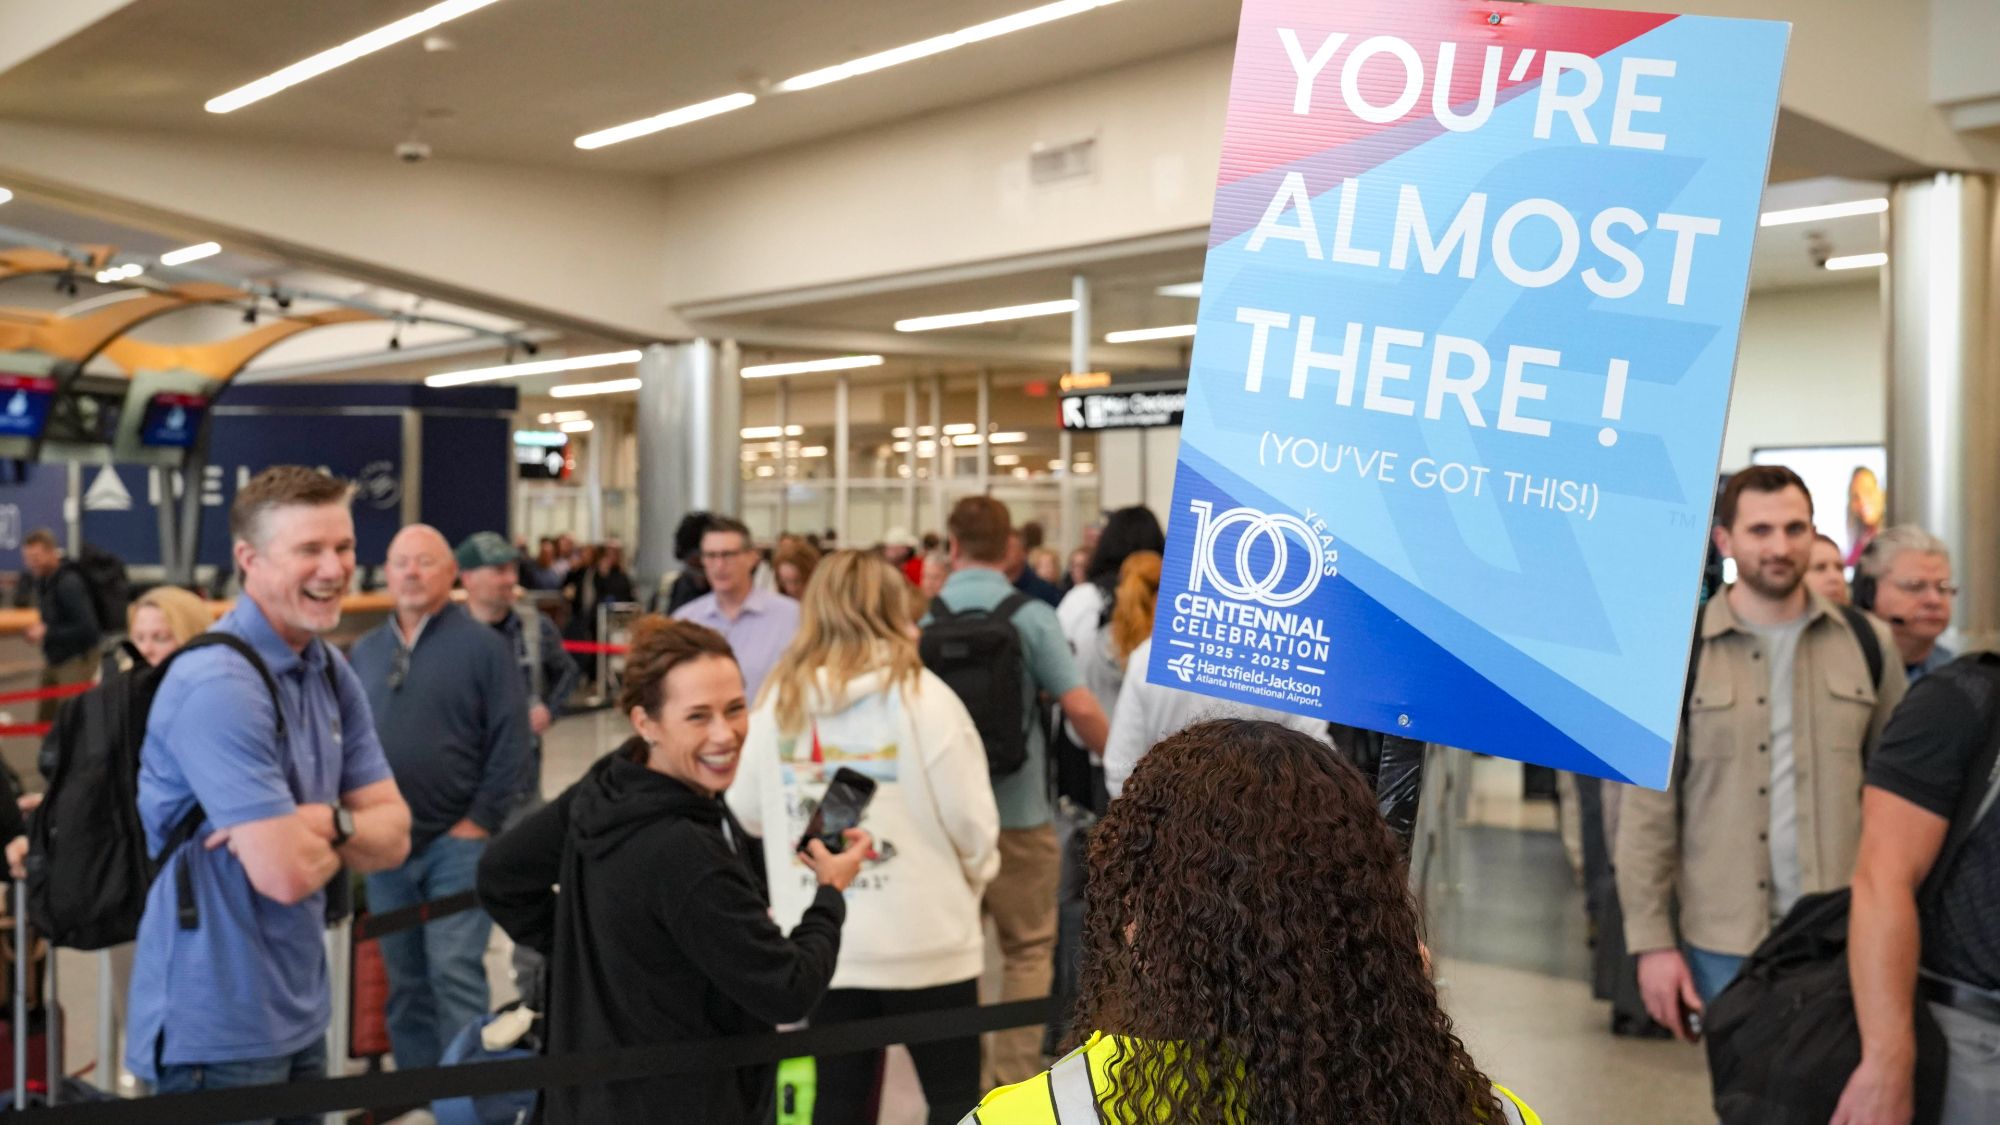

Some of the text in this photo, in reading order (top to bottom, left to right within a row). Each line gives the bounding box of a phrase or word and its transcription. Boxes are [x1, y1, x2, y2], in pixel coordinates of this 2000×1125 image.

[1276, 27, 1677, 151] YOU'RE
[1244, 171, 1721, 306] ALMOST
[1235, 306, 1630, 447] THERE !
[1259, 430, 1599, 521] (YOU'VE GOT THIS!)
[1188, 498, 1324, 608] 100
[1303, 507, 1338, 577] YEARS
[1172, 615, 1329, 662] CELEBRATION
[1174, 592, 1331, 643] CENTENNIAL
[1195, 673, 1228, 689] Atlanta
[1229, 680, 1285, 700] International
[1197, 658, 1321, 697] Hartsfield-Jackson
[1199, 641, 1234, 660] 1925
[1250, 652, 1291, 671] 2025
